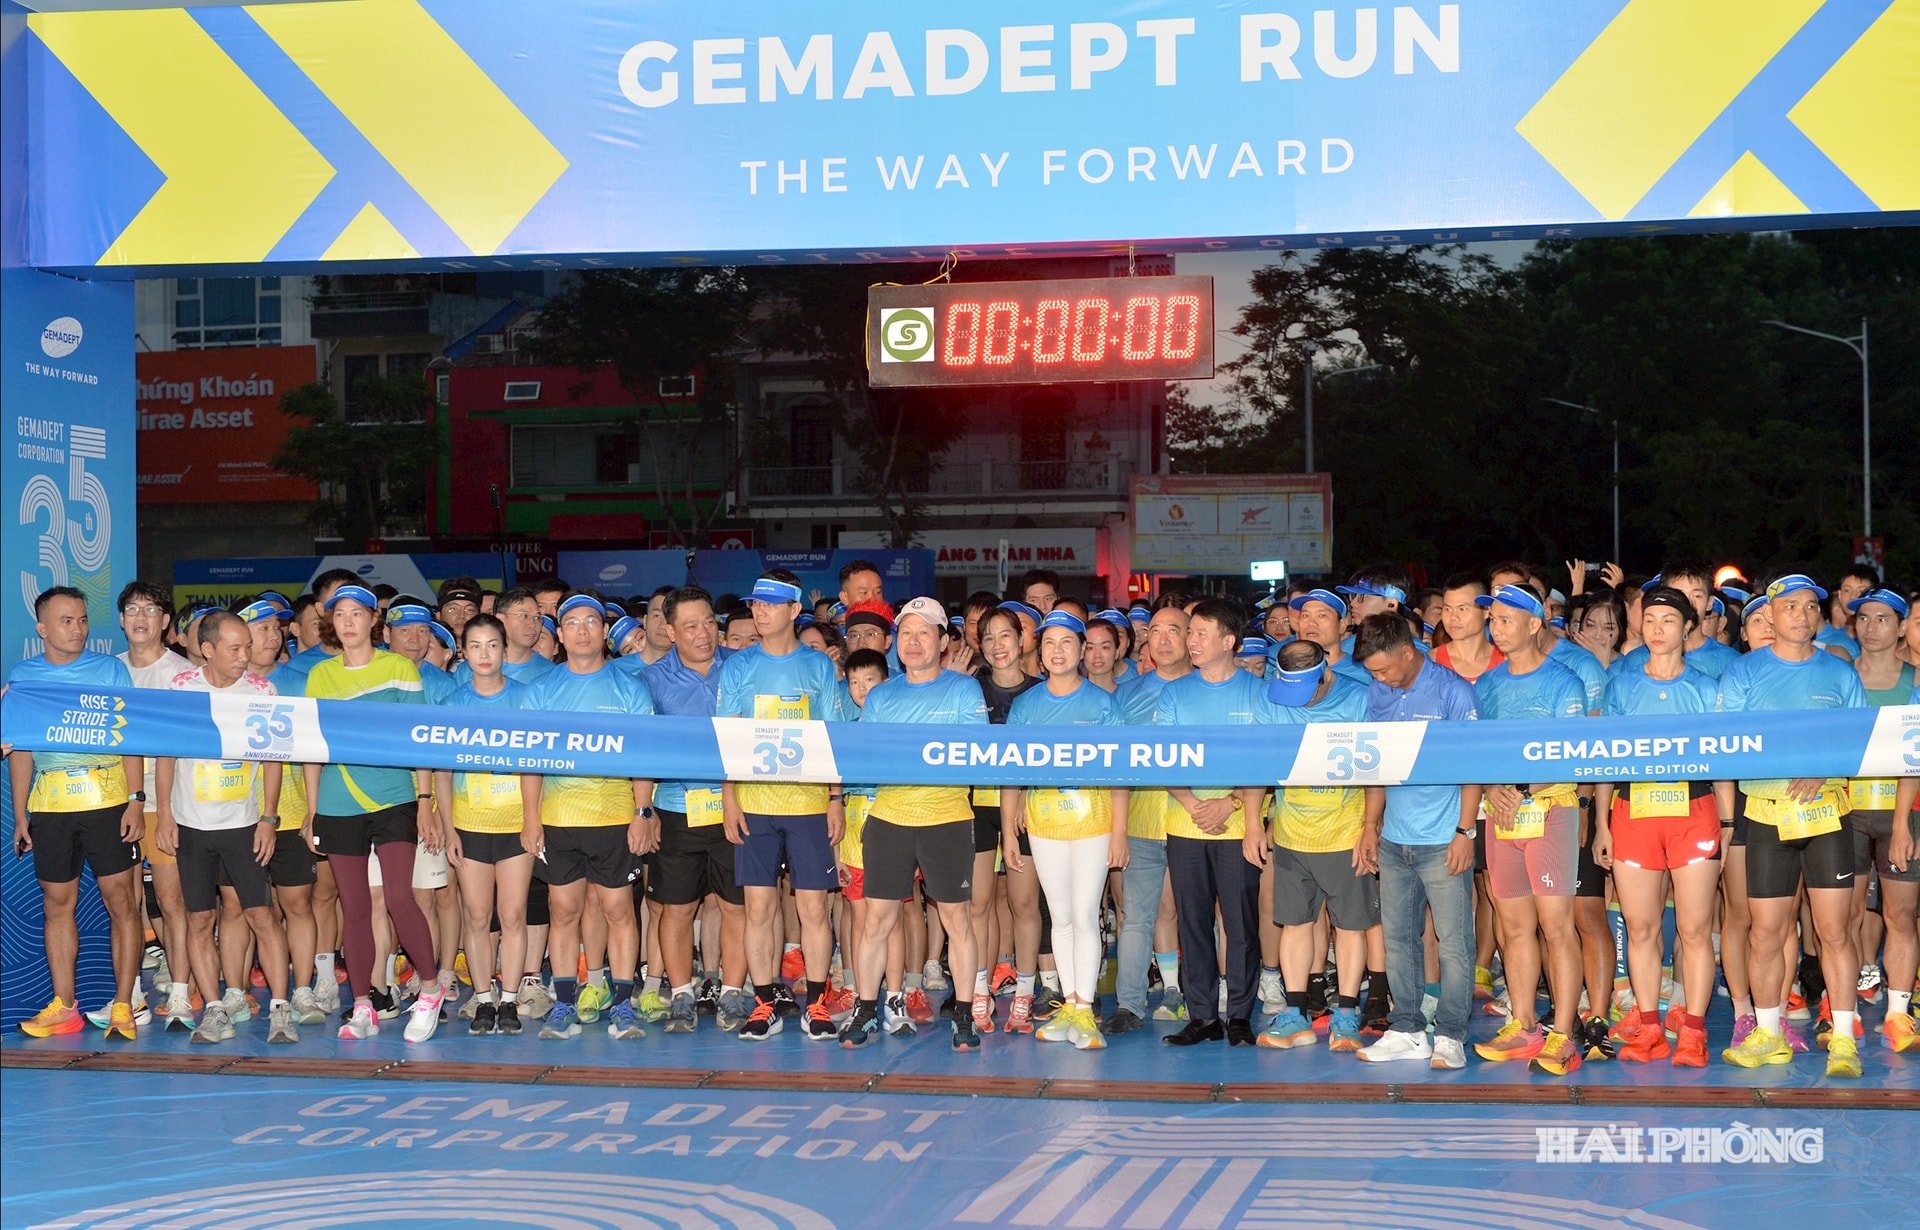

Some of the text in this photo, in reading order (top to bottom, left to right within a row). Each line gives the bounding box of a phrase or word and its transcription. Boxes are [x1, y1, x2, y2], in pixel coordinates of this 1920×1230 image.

[618, 3, 1460, 109] GEMADEPT RUN
[740, 138, 1356, 195] THE WAY FORWARD
[442, 257, 614, 270] RISE
[1203, 228, 1572, 249] CONQUER
[43, 328, 81, 345] GEMADEPT
[944, 295, 1200, 366] 00:00:00
[25, 362, 98, 385] THE WAY FORWARD
[200, 372, 275, 398] Khoán
[18, 415, 65, 442] GEMADEPT
[190, 408, 254, 429] Asset
[18, 442, 65, 465] CORPORATION
[490, 542, 542, 554] COFFEE
[766, 553, 827, 562] GEMADEPT RUN
[80, 694, 109, 711] RISE
[61, 709, 109, 727] STRIDE
[777, 708, 803, 720] 50880
[46, 725, 106, 746] CONQUER
[410, 724, 624, 753] GEMADEPT RUN
[243, 751, 293, 761] ANNIVERSARY
[921, 741, 1205, 768] GEMADEPT RUN
[1522, 734, 1763, 761] GEMADEPT RUN
[456, 753, 575, 770] SPECIAL EDITION
[1574, 763, 1710, 777] SPECIAL EDITION
[219, 775, 245, 788] 50871
[490, 781, 518, 794] 50869
[1650, 790, 1685, 803] F50053
[1797, 805, 1835, 823] M50192
[295, 1093, 970, 1135] GEMADEPT
[230, 1124, 935, 1163] CORPORATION
